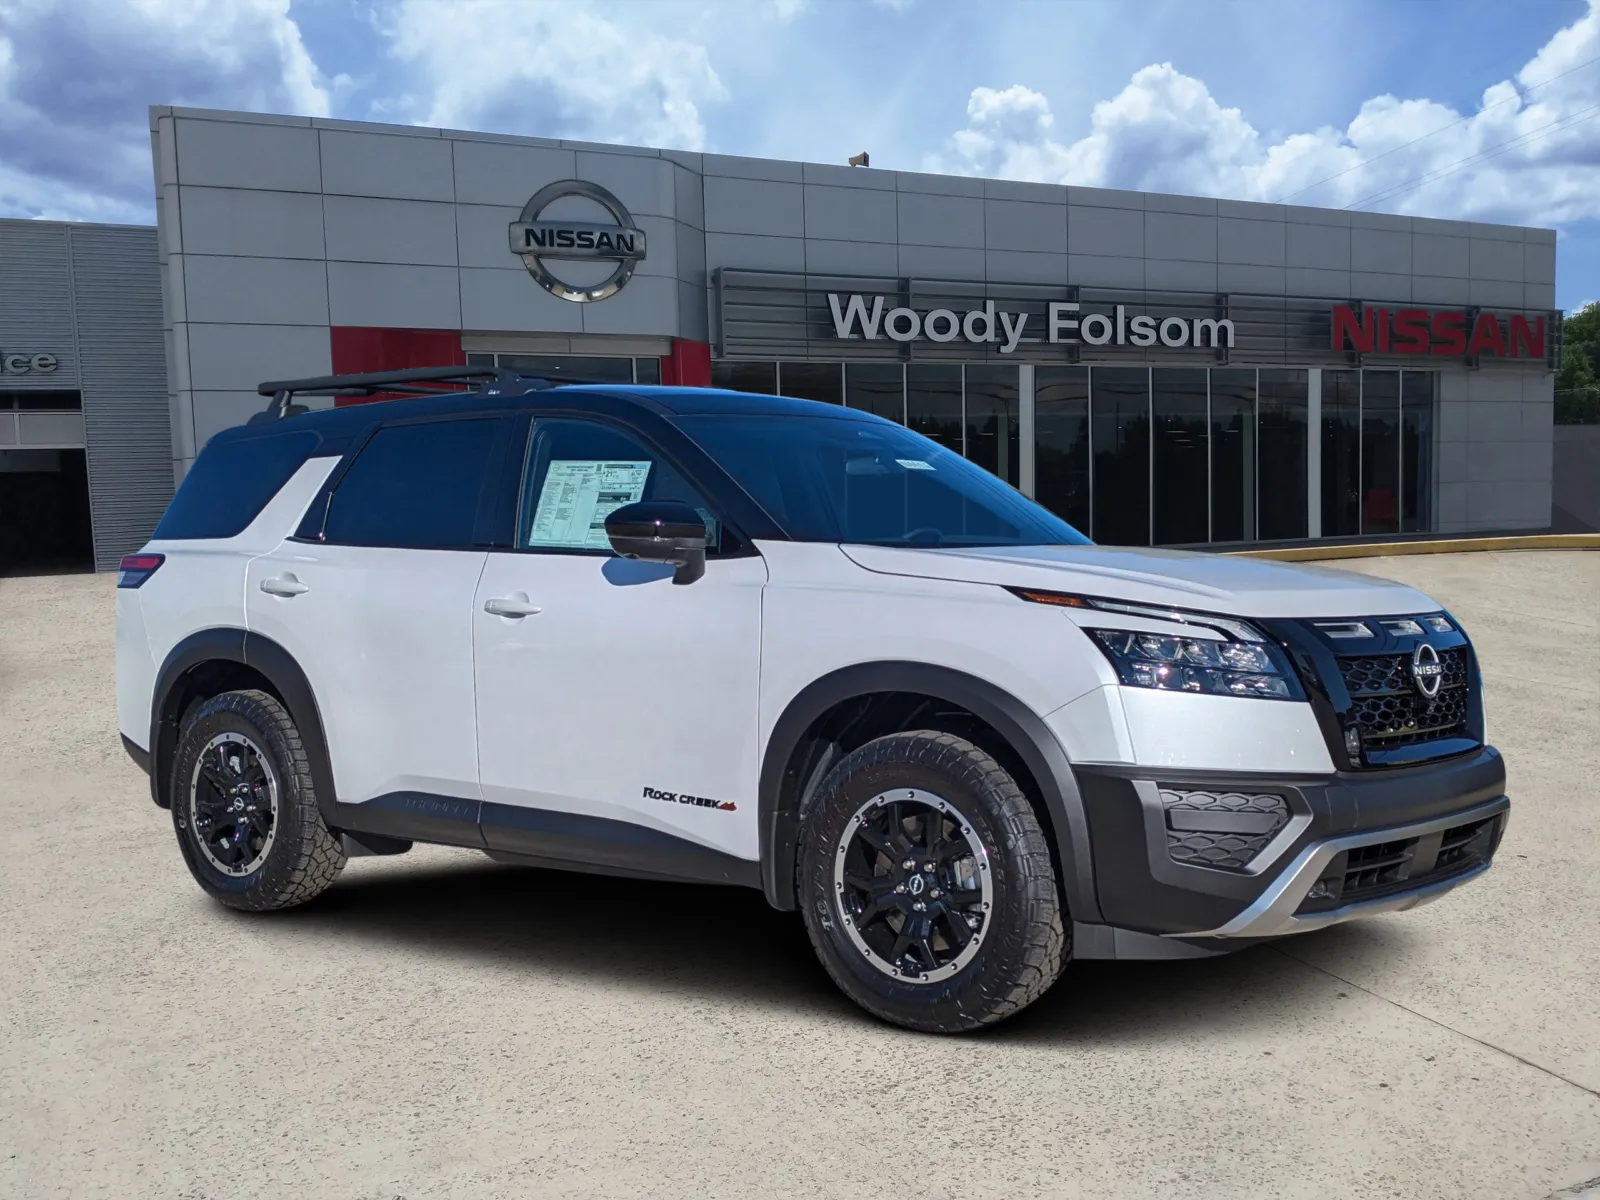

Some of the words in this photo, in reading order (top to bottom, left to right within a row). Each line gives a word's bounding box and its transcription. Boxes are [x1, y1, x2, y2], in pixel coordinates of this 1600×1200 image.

[524, 228, 636, 252] NISSAN
[827, 293, 1029, 354] Woody
[1047, 301, 1236, 348] Folsom
[1331, 305, 1545, 358] NISSAN
[0, 353, 57, 374] ce
[642, 786, 678, 803] ROCK
[678, 794, 721, 810] CREEK
